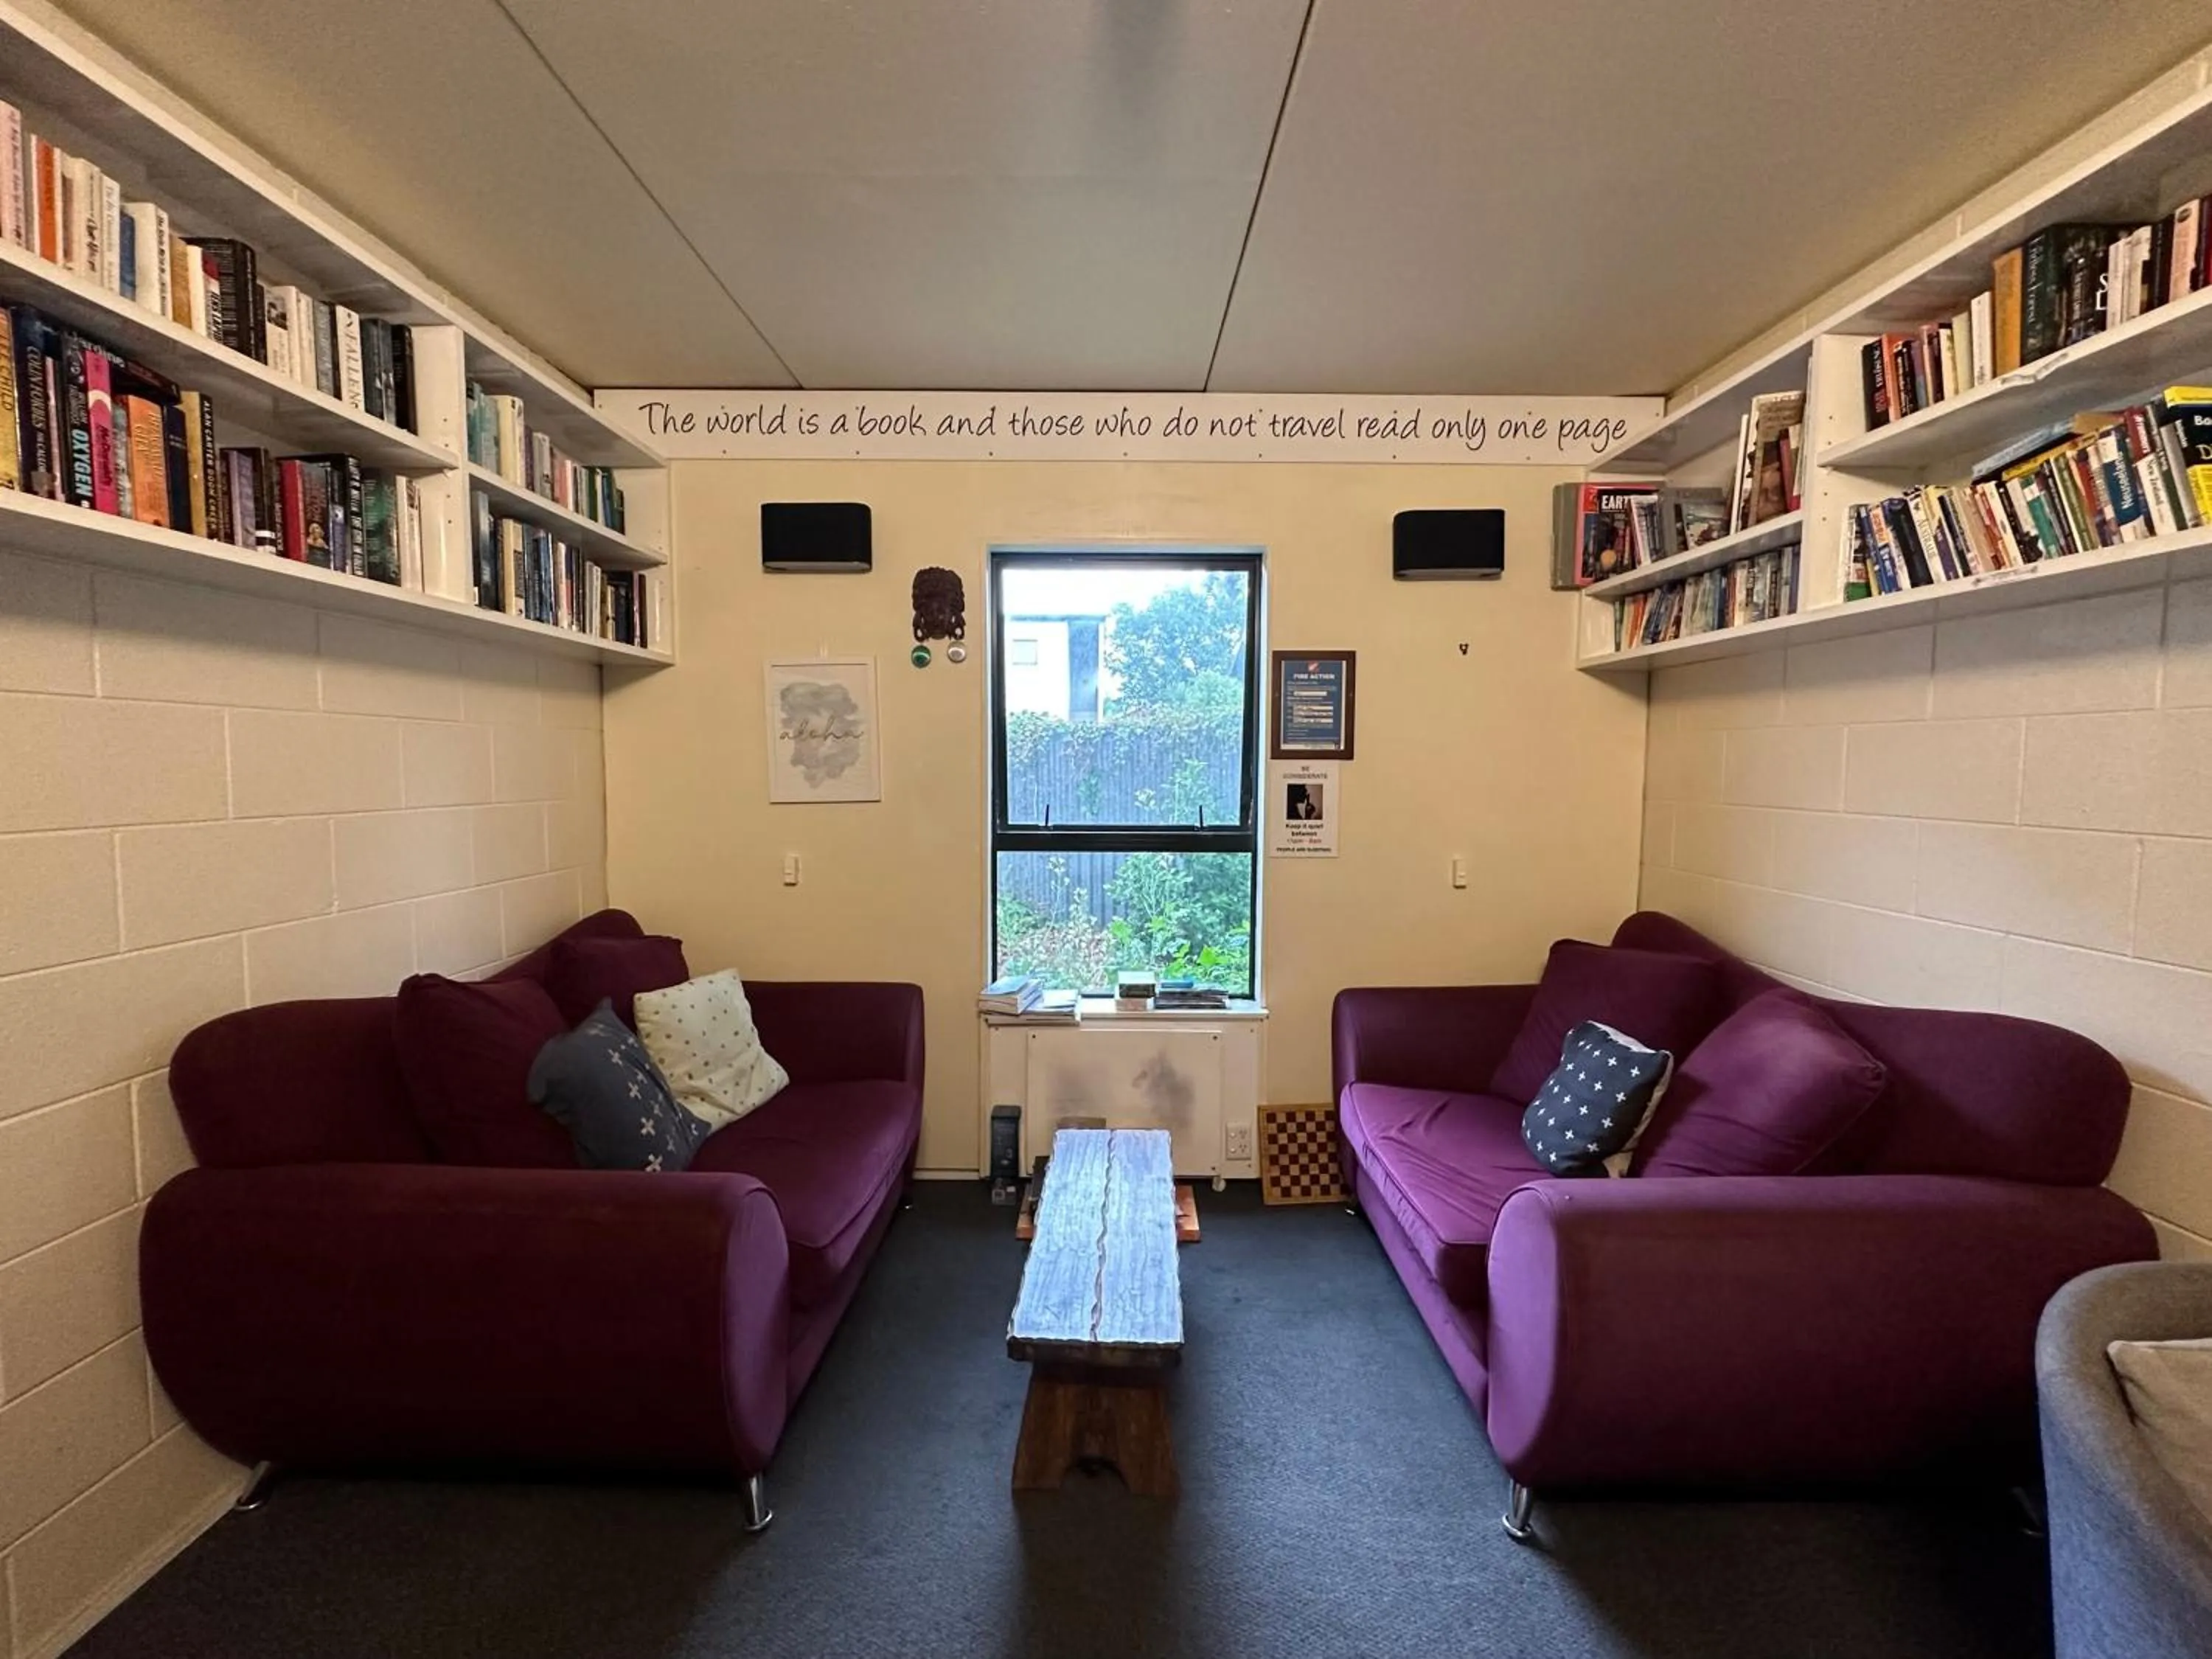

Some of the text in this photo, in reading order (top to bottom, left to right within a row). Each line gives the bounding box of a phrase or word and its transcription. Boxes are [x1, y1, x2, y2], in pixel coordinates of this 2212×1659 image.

[344, 332, 362, 403] FALLEN
[205, 428, 215, 467] CARTER
[638, 402, 1627, 453] The world is a book and those who do not travel read only one page
[71, 428, 93, 497] OXYGEN
